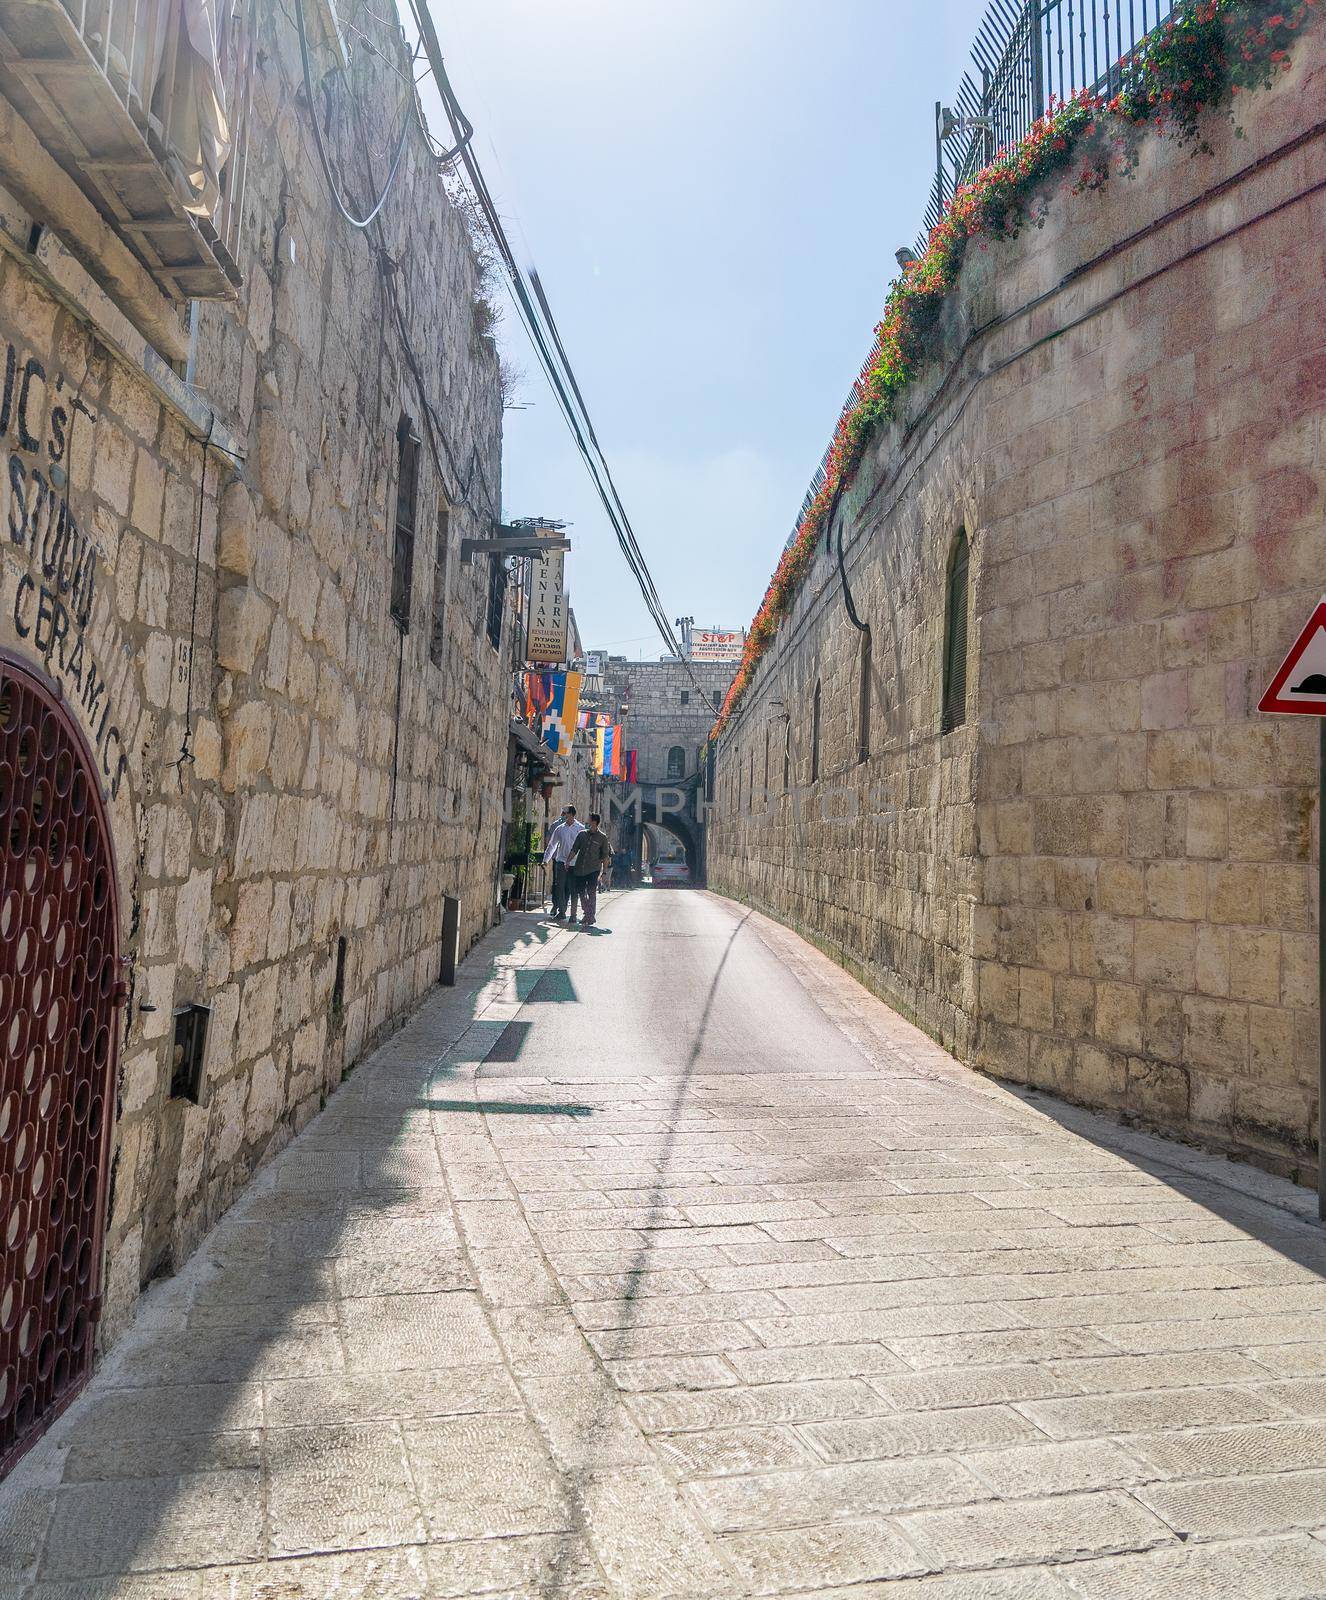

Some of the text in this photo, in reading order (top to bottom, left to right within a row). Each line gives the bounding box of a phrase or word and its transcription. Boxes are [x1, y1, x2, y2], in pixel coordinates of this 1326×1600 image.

[8, 456, 97, 631] STUDIO
[552, 558, 562, 628] TAVERN
[532, 629, 564, 637] RESTAURANT
[702, 633, 735, 642] STOP
[14, 573, 128, 802] CERAMICS
